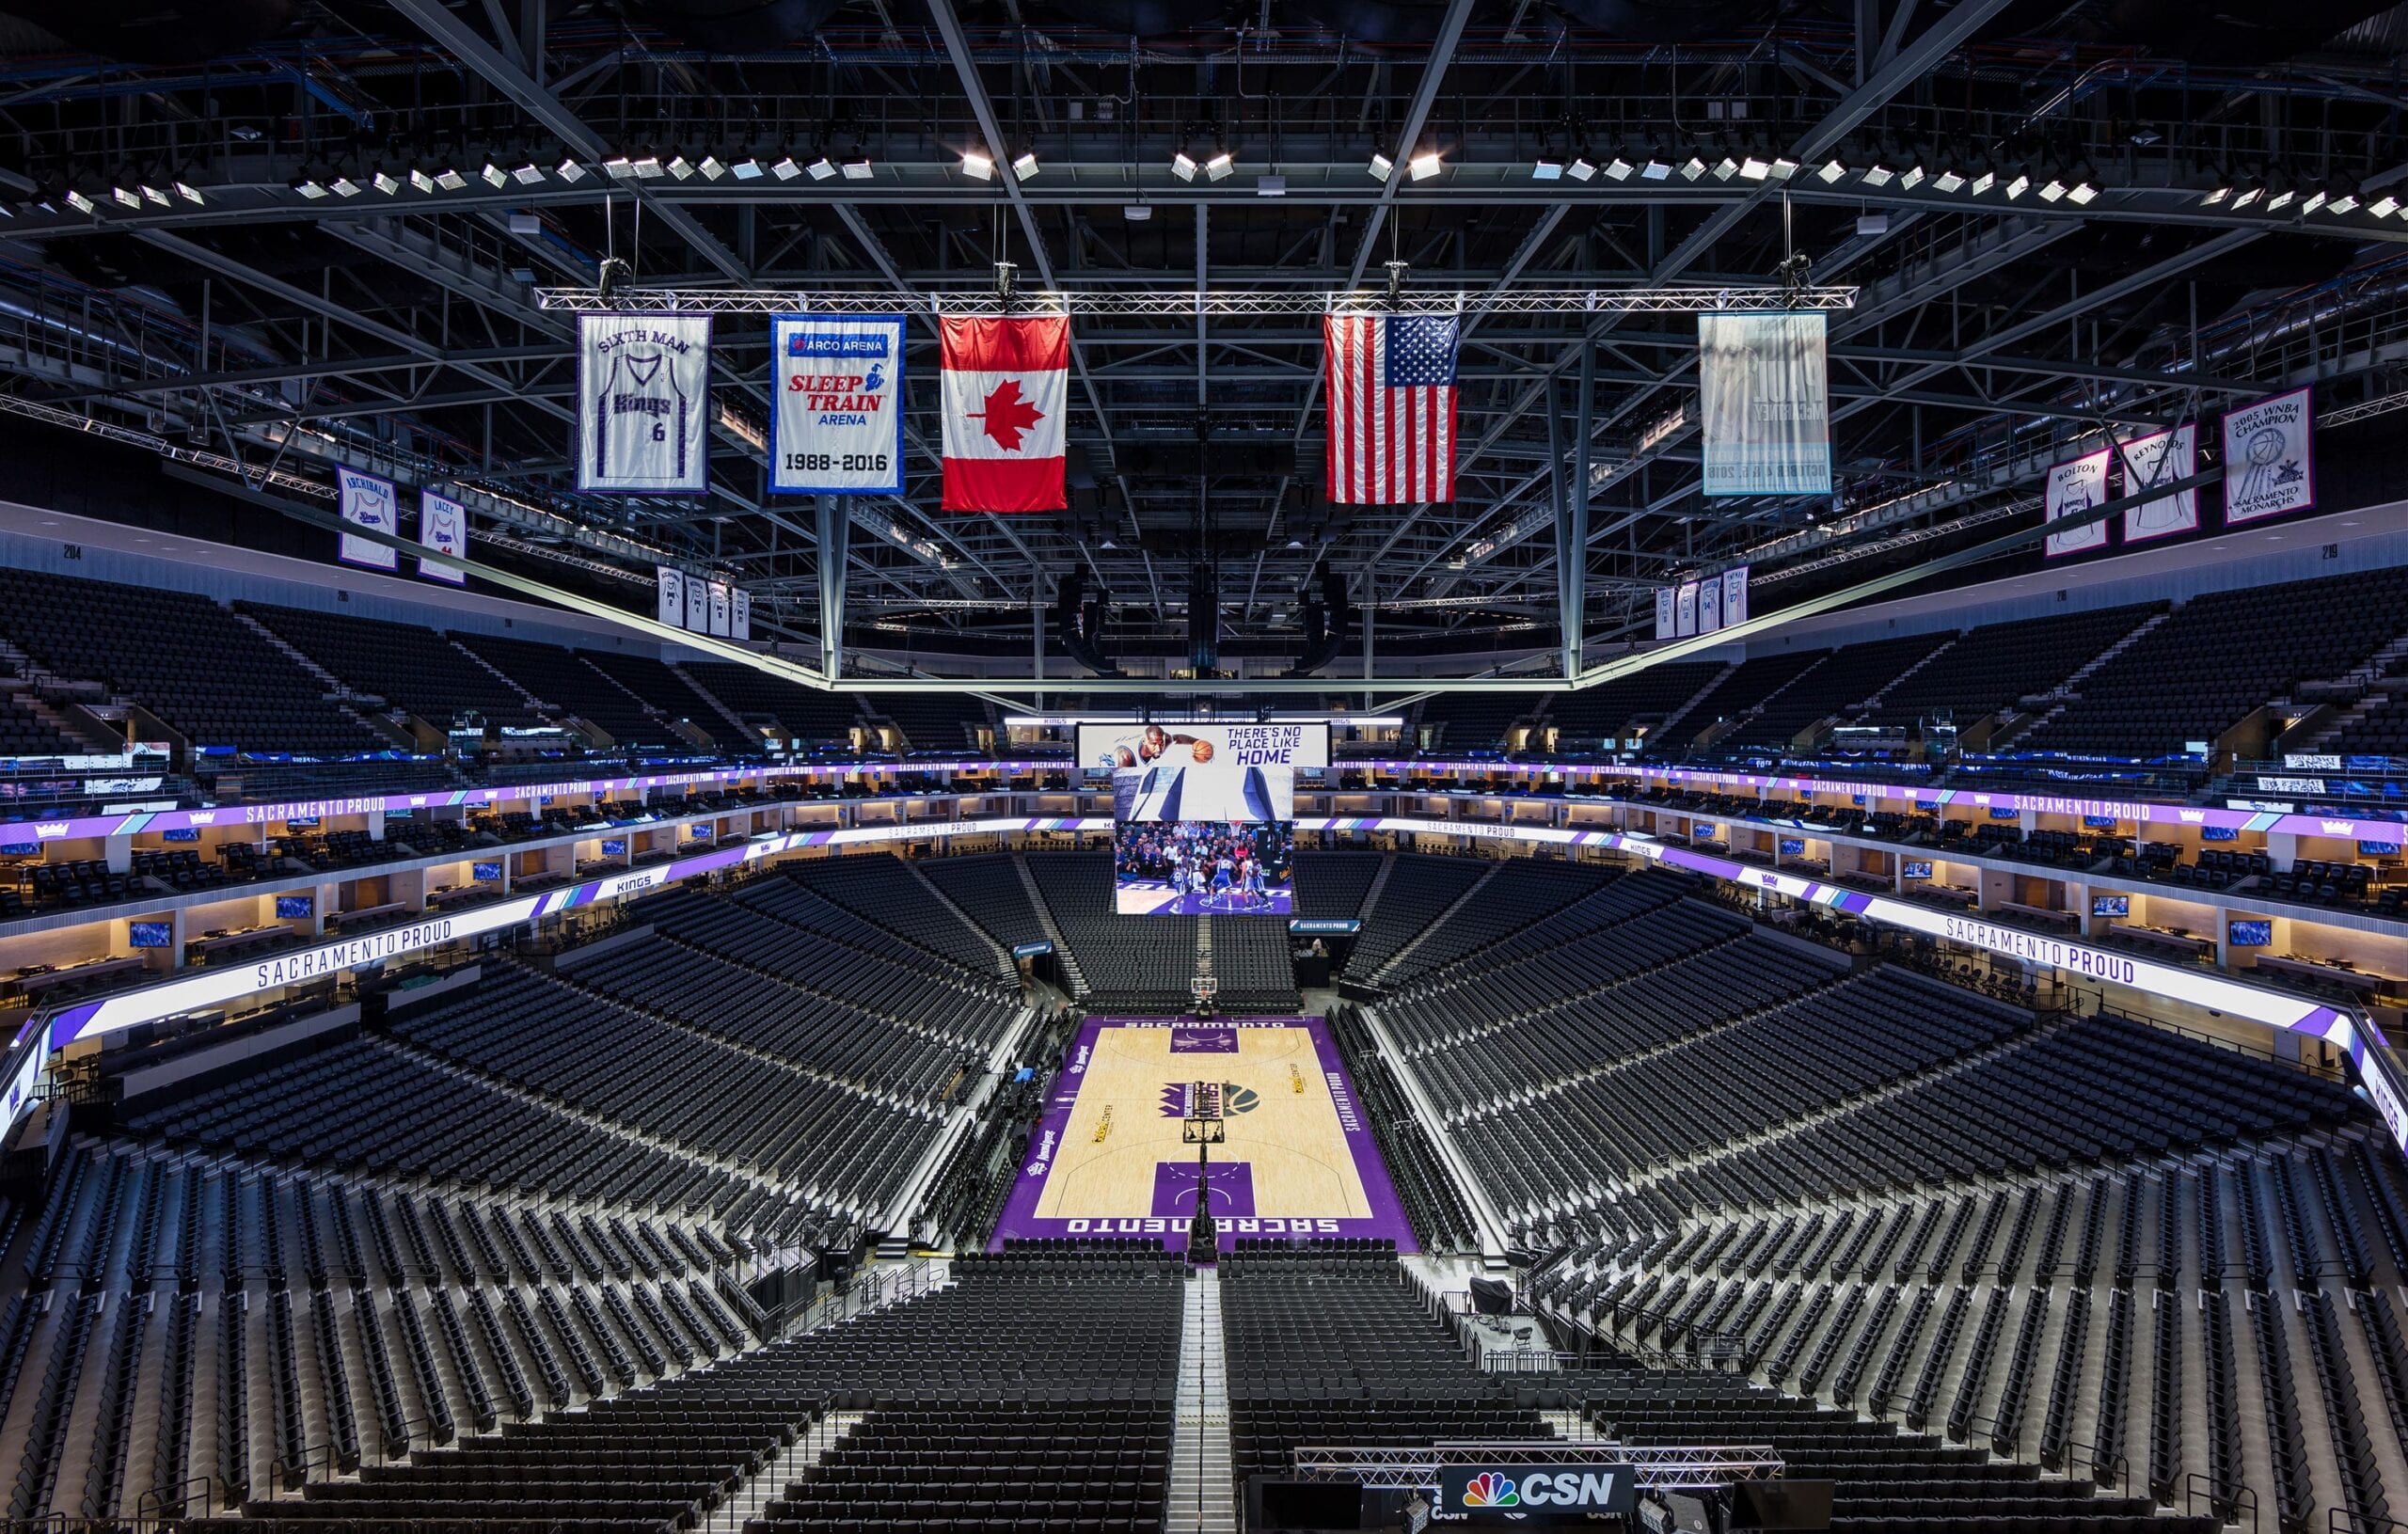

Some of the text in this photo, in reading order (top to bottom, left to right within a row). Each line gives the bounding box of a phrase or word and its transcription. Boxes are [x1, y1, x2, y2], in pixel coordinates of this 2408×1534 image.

[598, 329, 690, 355] SIXTH MAN
[807, 340, 882, 351] ARCO ARENA
[788, 375, 863, 393] SLEEP
[614, 393, 672, 419] Kings
[807, 394, 882, 412] TRAIN
[818, 414, 866, 426] ARENA
[2233, 403, 2300, 430] 2005 WNBA
[652, 422, 666, 442] 6
[2236, 414, 2297, 438] CHAMPION
[2133, 439, 2185, 462] REYNODS
[785, 453, 887, 471] 1988-2016
[2057, 464, 2099, 482] BOLTON
[346, 477, 388, 499] ARCHIBALD
[2237, 486, 2299, 507] SACRAMENTO
[434, 500, 454, 514] LACEY
[2241, 497, 2295, 514] MONARCHS
[64, 545, 81, 561] 204
[2322, 544, 2337, 560] 219
[1228, 726, 1301, 739] THERE'S NO
[1228, 737, 1301, 750] PLACE LIKE
[1237, 750, 1291, 766] HOME
[1448, 763, 1487, 771] SACRAMENTO
[899, 764, 939, 772] SACRAMENTO
[1691, 771, 1721, 783] SACRAMENTO
[666, 773, 699, 785] SACRAMENTO
[515, 781, 592, 799] SACRAMENTO PROUD
[1812, 781, 1888, 798] SACRAMENTO PROUD
[246, 797, 386, 822] SACRAMENTO PROUD
[2014, 796, 2150, 820] SACRAMENTO PROUD
[951, 822, 977, 833] PROUD
[1427, 822, 1515, 837] SACRAMENTO PROUD
[1630, 844, 1651, 855] KINGS
[617, 876, 651, 893] KINGS
[258, 920, 451, 988] SACRAMENTO PROUD
[1946, 918, 2134, 984] SACRAMENTO PROUD
[1325, 1072, 1361, 1131] SACRAMENTO PROUD
[2375, 1078, 2399, 1139] KINGS
[1521, 1473, 1615, 1506] CSN
